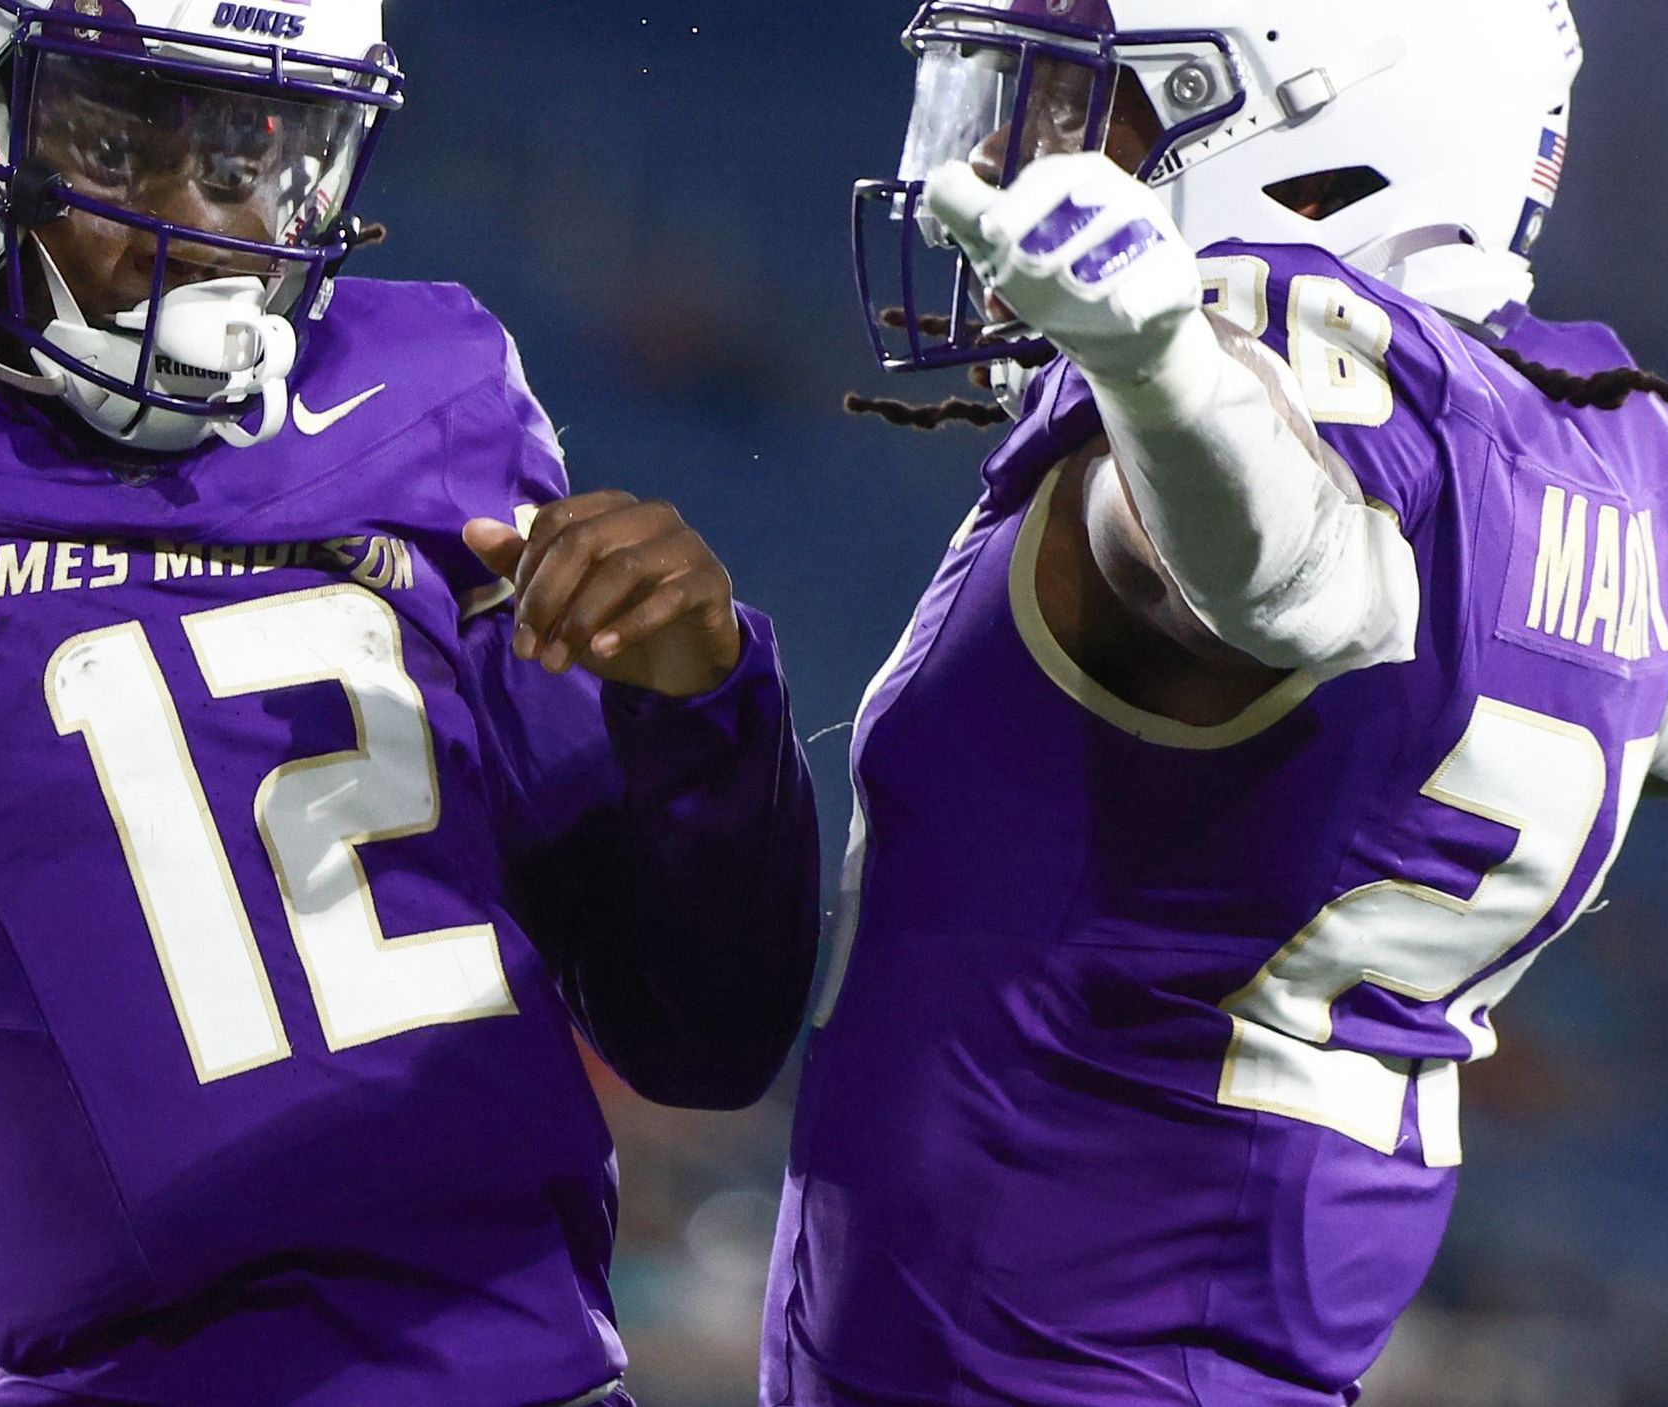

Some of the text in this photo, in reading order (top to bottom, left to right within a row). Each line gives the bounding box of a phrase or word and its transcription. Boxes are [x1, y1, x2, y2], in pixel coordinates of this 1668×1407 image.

[212, 2, 306, 39] DUKES
[44, 583, 520, 1084] 12
[1216, 694, 1658, 1168] 2
